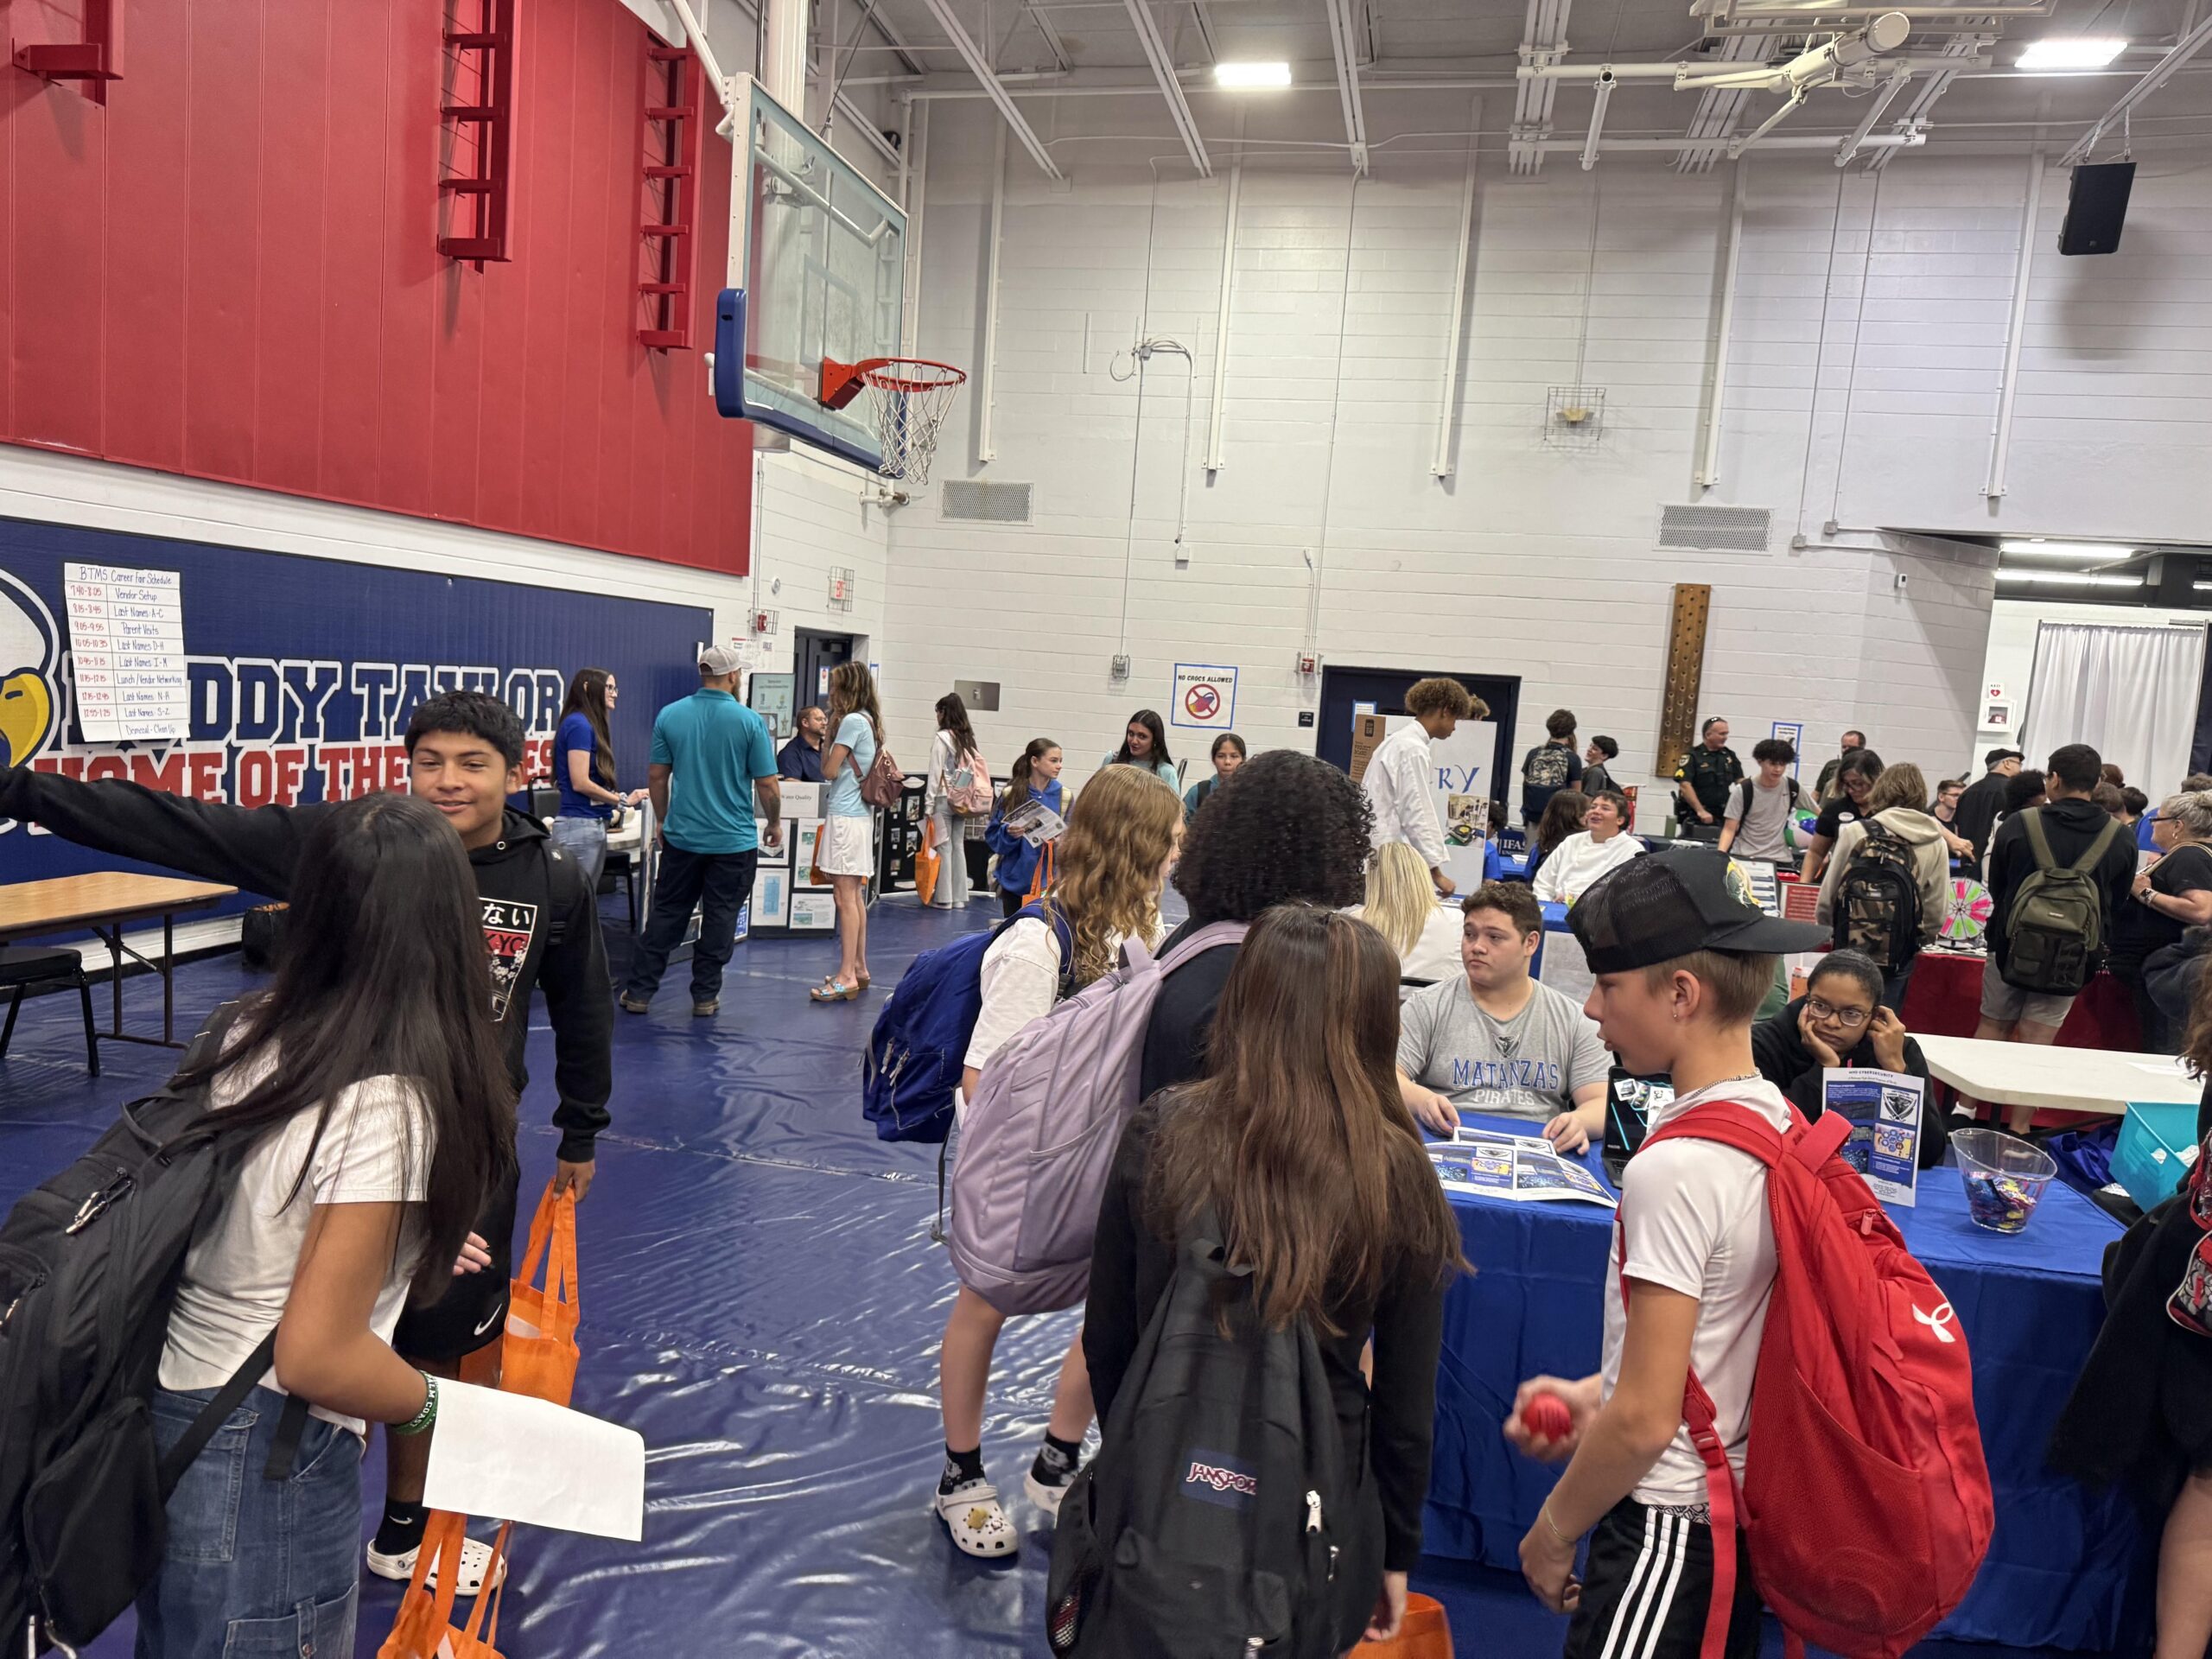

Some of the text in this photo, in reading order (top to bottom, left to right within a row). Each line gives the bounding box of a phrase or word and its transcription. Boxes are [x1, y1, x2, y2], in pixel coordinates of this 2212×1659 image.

[79, 566, 108, 581] BTMS
[111, 567, 133, 582] Career
[146, 572, 172, 585] Schedule
[115, 588, 157, 602] Vendor Setup
[113, 606, 129, 618] Last
[120, 621, 142, 635] Parent
[117, 639, 131, 651] Last
[118, 656, 132, 667] Last
[117, 672, 136, 684] Lunch
[123, 690, 136, 702] Last
[124, 708, 137, 718] Last
[237, 746, 307, 810] OF
[1452, 1057, 1560, 1091] MATANZAS
[1472, 1089, 1535, 1106] PIRATES
